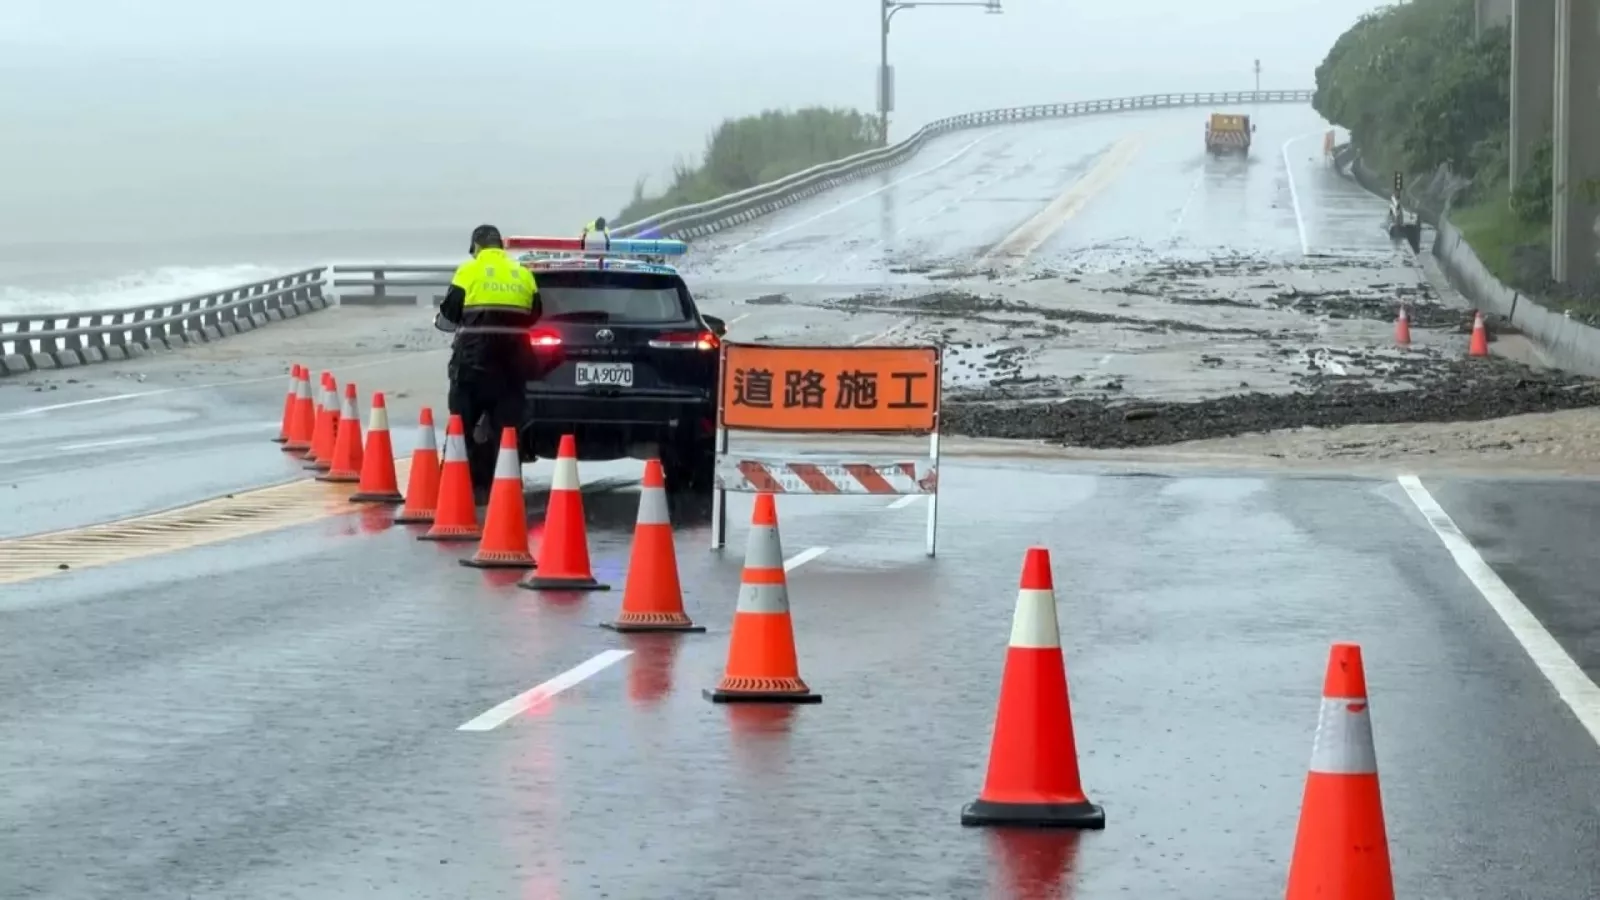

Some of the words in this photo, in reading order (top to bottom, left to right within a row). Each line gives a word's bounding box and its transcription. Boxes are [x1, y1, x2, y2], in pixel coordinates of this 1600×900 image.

[577, 367, 632, 383] BLA-9070
[732, 368, 928, 409] 道路施工
